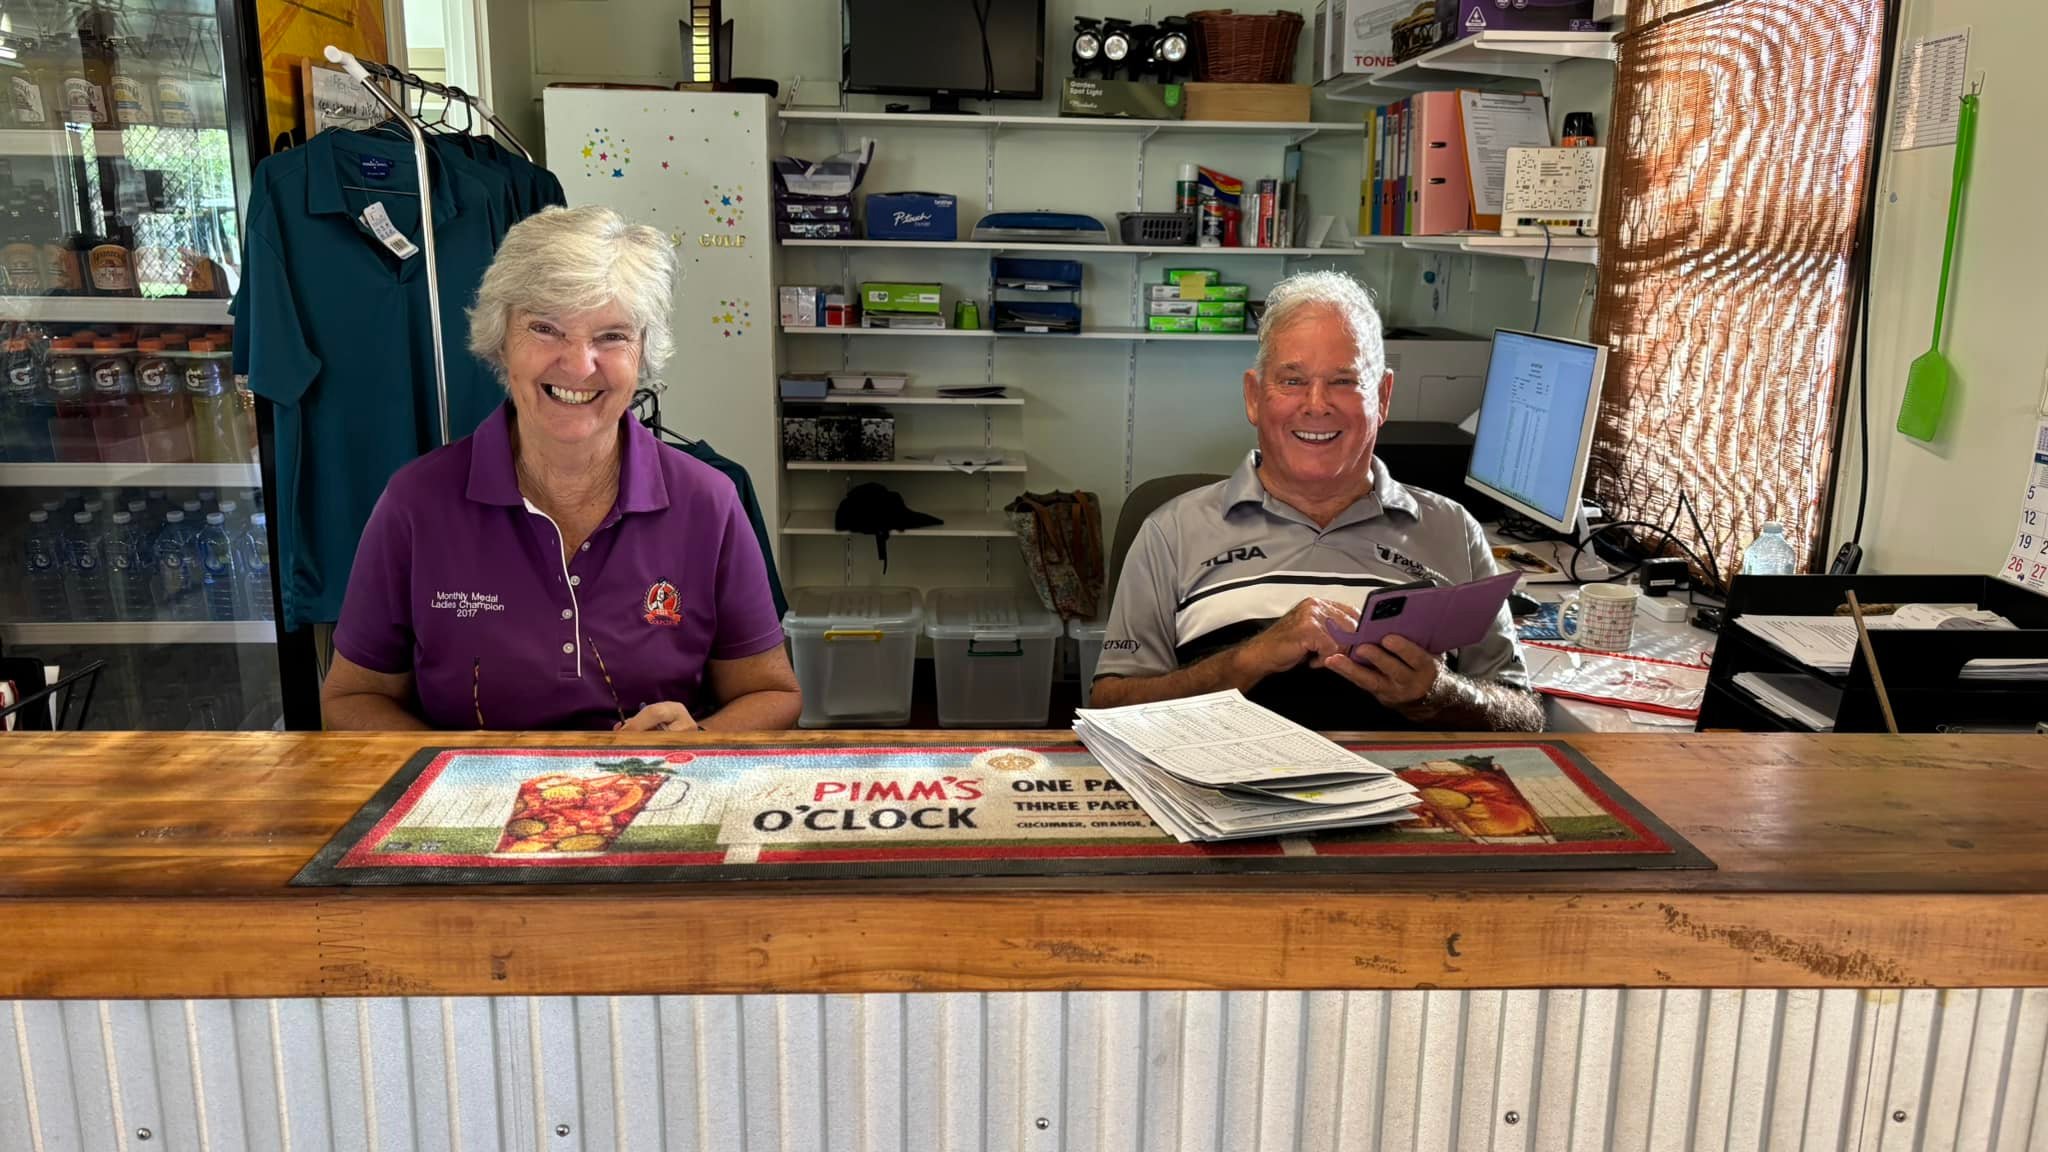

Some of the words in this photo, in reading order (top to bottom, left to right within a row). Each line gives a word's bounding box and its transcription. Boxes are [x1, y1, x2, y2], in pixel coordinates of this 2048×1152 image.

[1086, 89, 1103, 97] Light
[698, 234, 746, 248] GOLF
[2027, 485, 2036, 500] 5
[2024, 510, 2037, 526] 12
[2019, 534, 2032, 549] 19
[2007, 556, 2024, 573] 26
[2031, 563, 2047, 580] 27
[437, 592, 468, 600] Monthly
[472, 592, 498, 602] Medal
[432, 600, 456, 608] Ladies
[459, 601, 505, 610] Champion
[456, 609, 478, 617] 2017
[813, 776, 983, 802] PIMM'S
[1011, 779, 1074, 793] ONE
[1014, 801, 1080, 811] THREE
[753, 804, 978, 832] O'CLOCK
[1016, 820, 1087, 829] CUCUMBER,
[1090, 820, 1147, 829] ORANGE,
